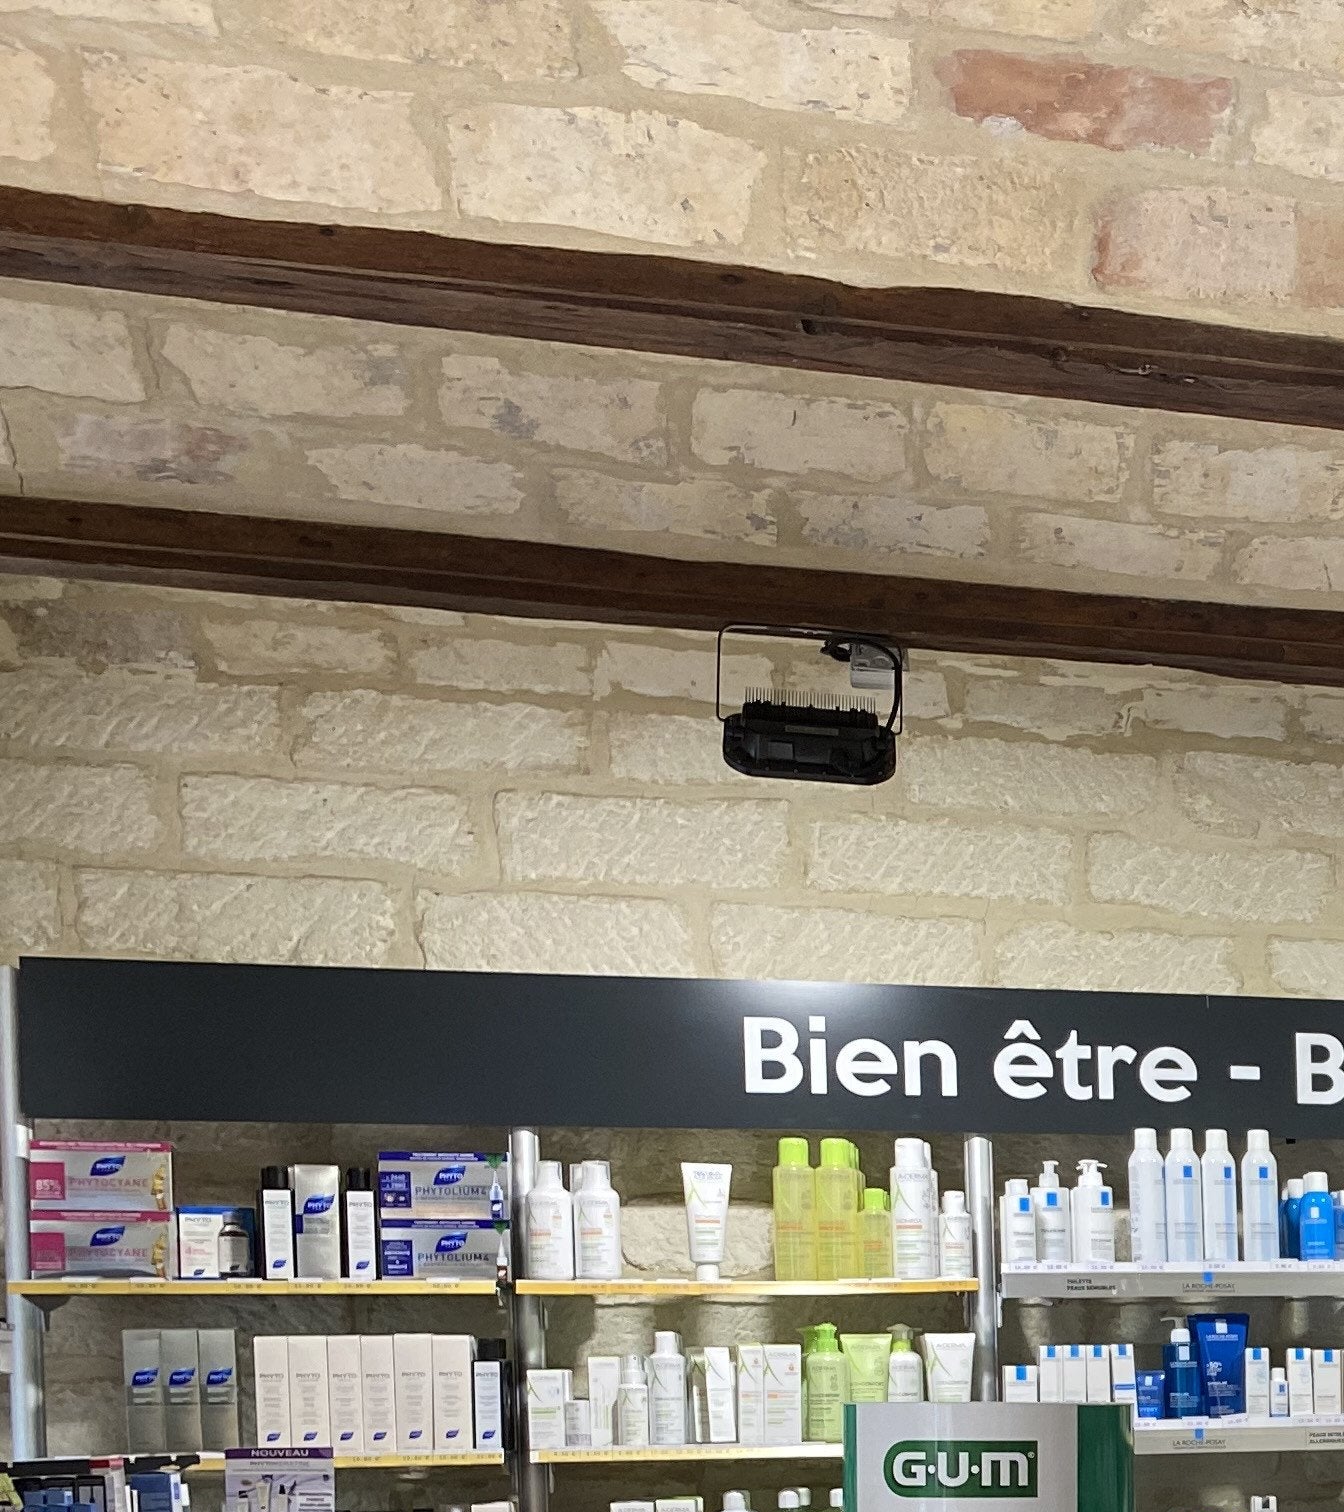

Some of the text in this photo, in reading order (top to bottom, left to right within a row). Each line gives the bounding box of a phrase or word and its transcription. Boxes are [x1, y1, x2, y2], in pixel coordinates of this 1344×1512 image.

[744, 1016, 958, 1097] Bien
[994, 1019, 1199, 1102] être
[1229, 1064, 1261, 1081] -
[250, 1448, 309, 1458] NOUVEAU
